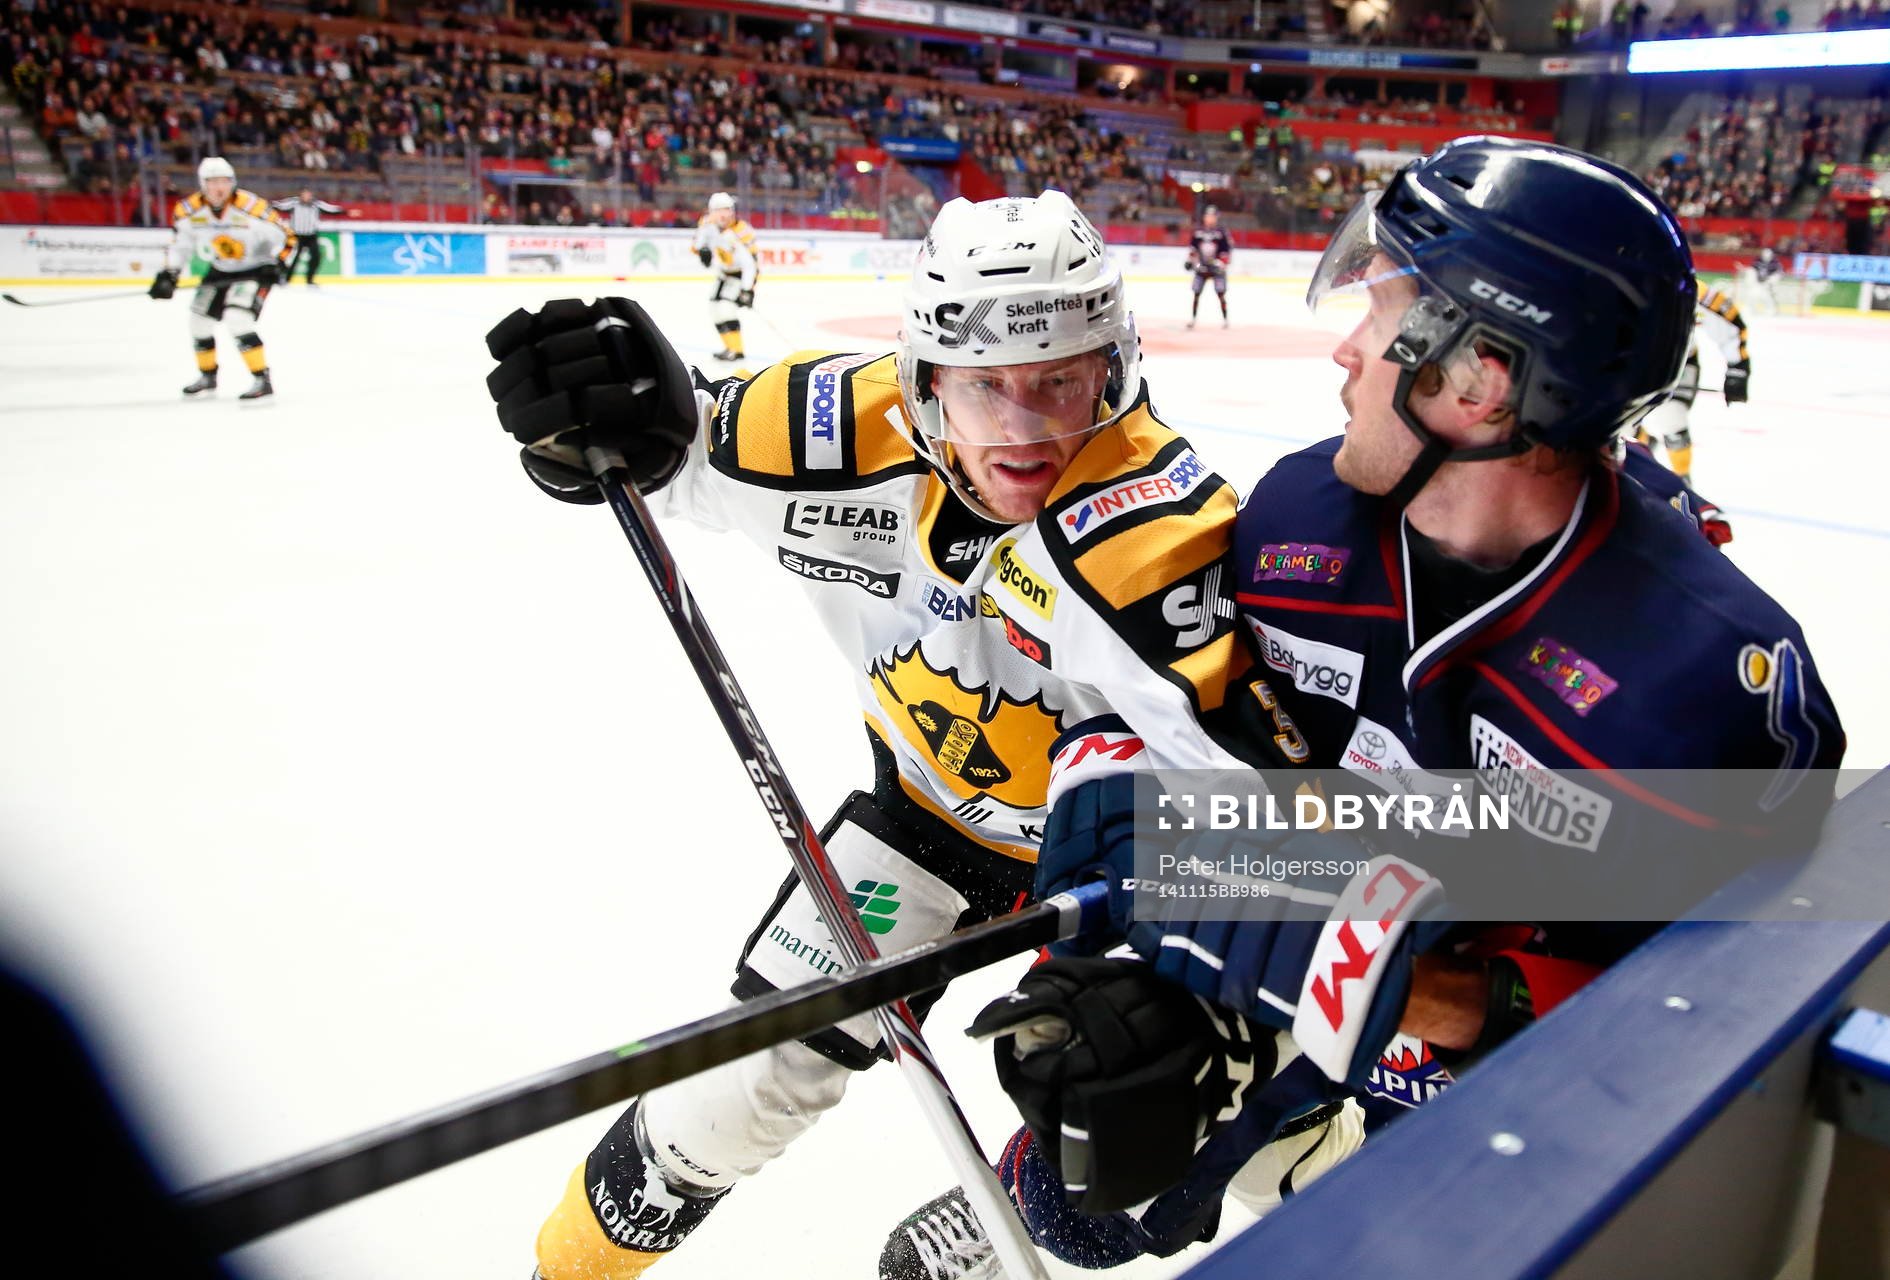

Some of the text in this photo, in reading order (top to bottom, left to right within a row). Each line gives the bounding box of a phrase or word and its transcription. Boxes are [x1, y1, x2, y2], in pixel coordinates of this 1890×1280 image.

[1006, 294, 1083, 318] Skellefteå
[1469, 278, 1552, 324] CCM
[1008, 318, 1049, 336] Kraft
[823, 505, 898, 531] LEAB
[853, 531, 896, 545] group
[783, 553, 890, 595] ŠKODA
[719, 671, 781, 777] CCM
[1348, 750, 1383, 776] TOYOTA
[1503, 741, 1526, 770] NEW
[969, 766, 1001, 778] 1921
[745, 757, 798, 838] CCM
[1475, 738, 1597, 844] LEGENDS
[668, 1143, 719, 1178] CCM
